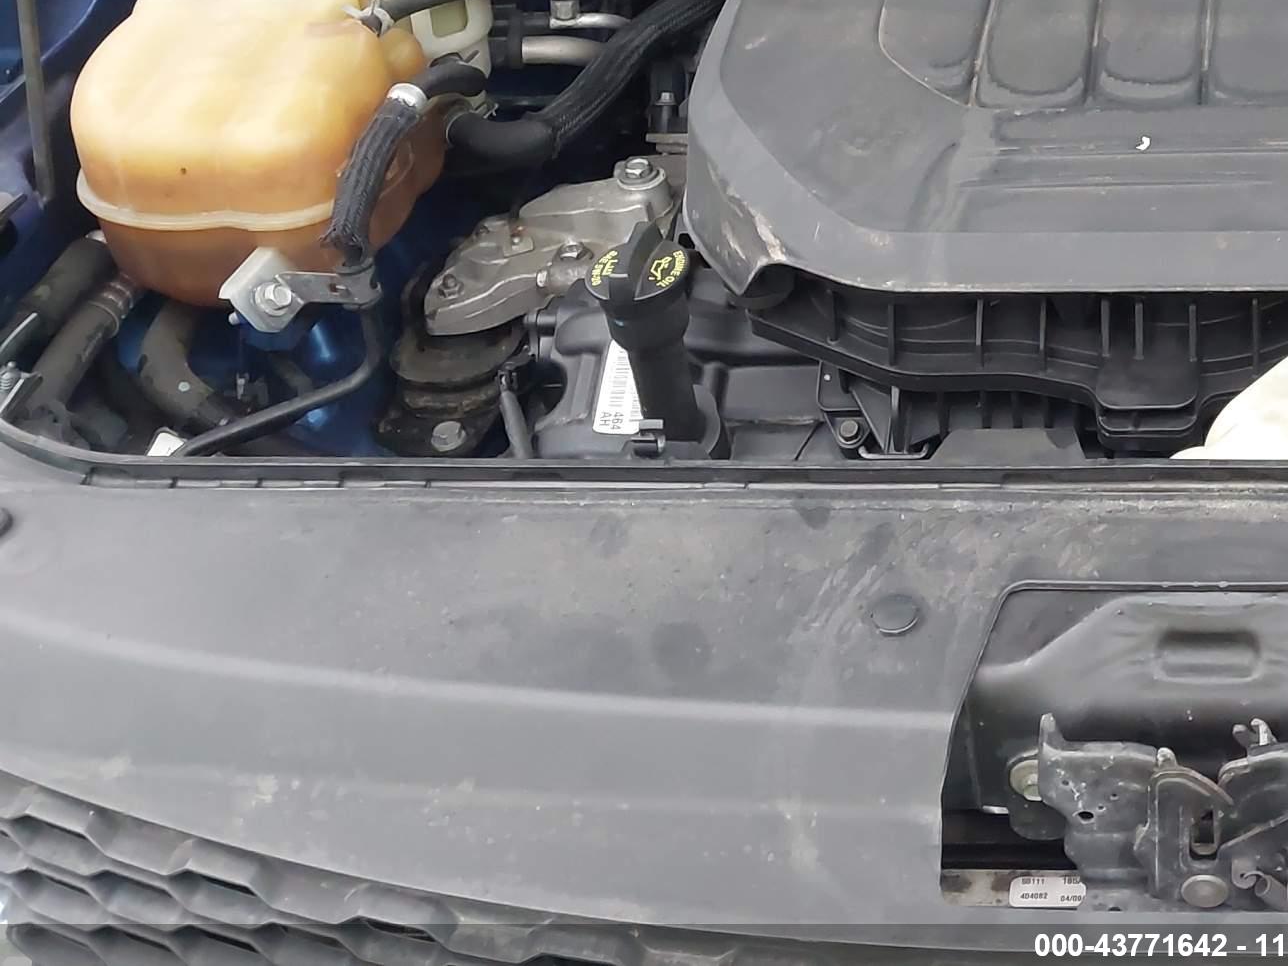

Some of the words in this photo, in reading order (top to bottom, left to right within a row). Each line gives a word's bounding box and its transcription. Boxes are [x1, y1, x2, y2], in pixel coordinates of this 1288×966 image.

[673, 250, 687, 277] ENGINE
[656, 276, 676, 288] OIL
[599, 411, 612, 426] AH
[610, 412, 625, 430] 464
